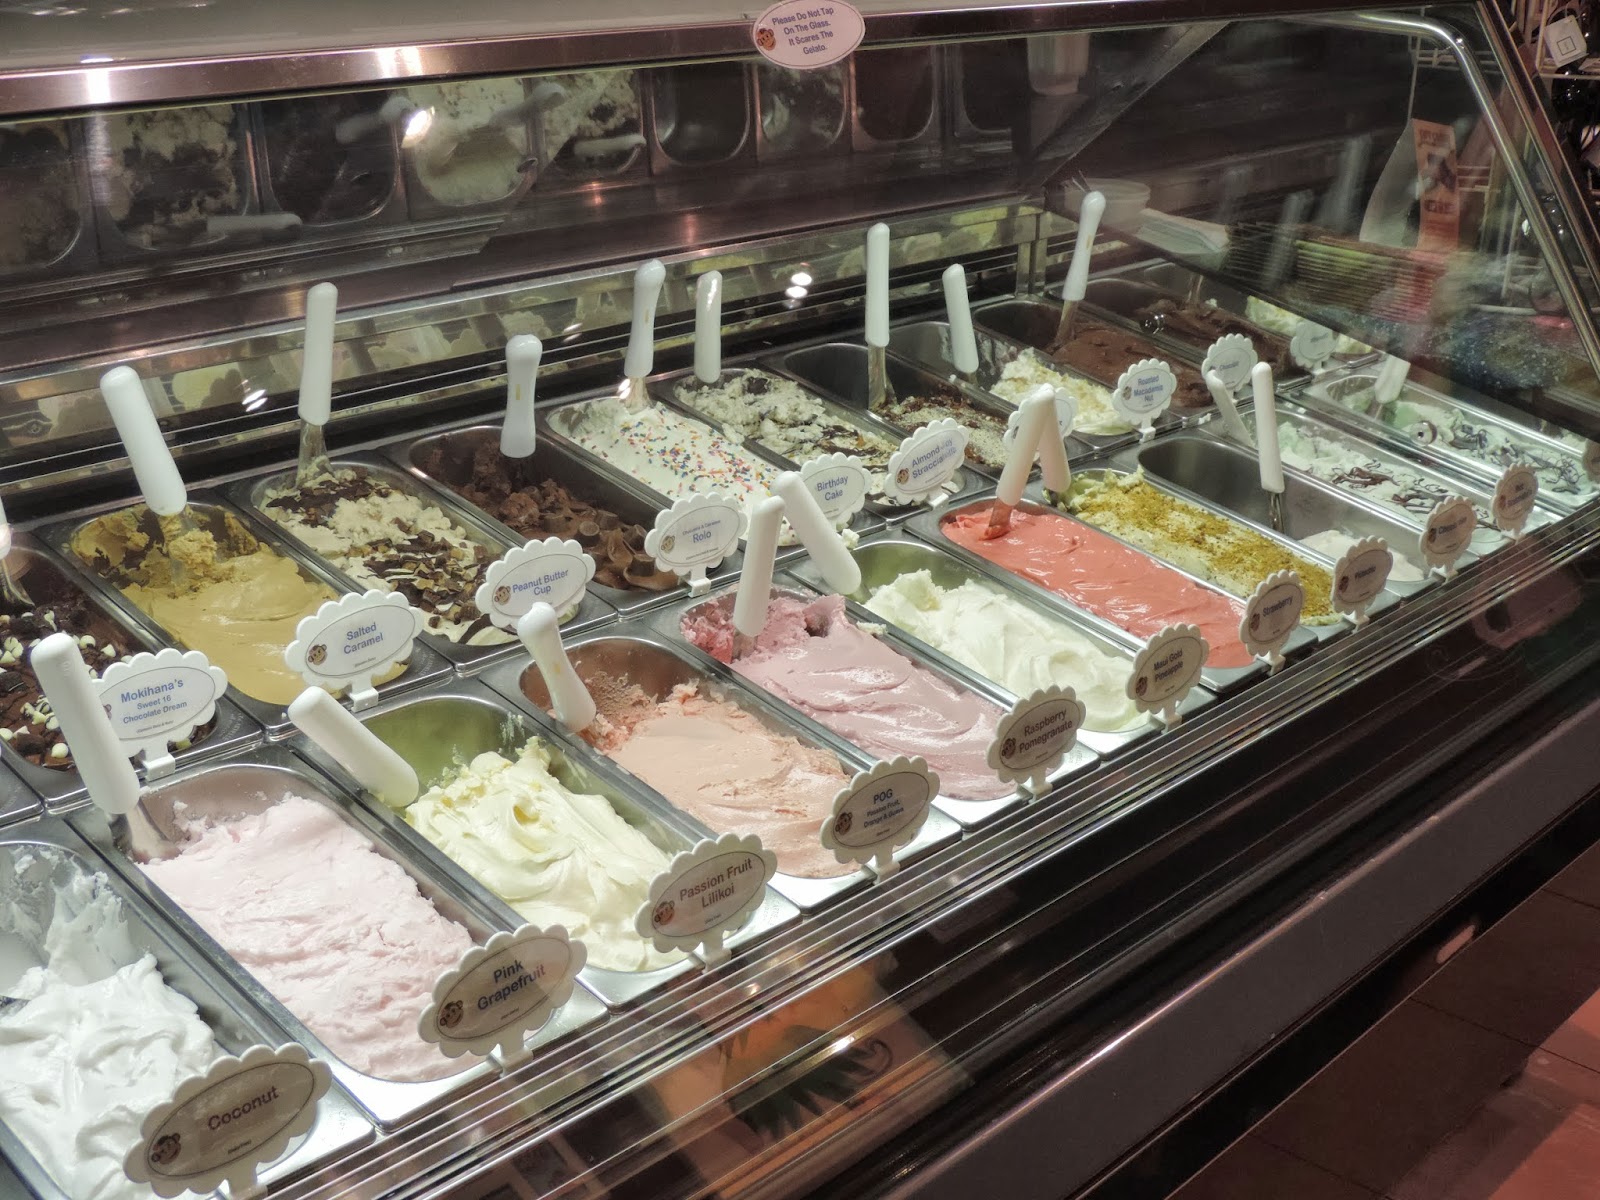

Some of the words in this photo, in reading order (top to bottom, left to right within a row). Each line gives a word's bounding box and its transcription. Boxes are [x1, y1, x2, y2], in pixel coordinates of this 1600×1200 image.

[772, 15, 796, 26] Please
[796, 12, 807, 21] Do
[807, 9, 821, 18] Not
[821, 7, 835, 16] Tap
[783, 27, 795, 36] On
[795, 24, 809, 32] The
[788, 38, 795, 47] It
[795, 33, 820, 45] Scares
[820, 30, 834, 39] The
[912, 444, 941, 468] Almond
[816, 475, 849, 492] Birthday
[824, 489, 844, 501] Cake
[692, 530, 712, 544] Rolo
[512, 576, 543, 593] Peanut
[543, 569, 569, 584] Butter
[533, 584, 552, 597] Cup
[1262, 595, 1293, 617] Strawberry
[346, 621, 377, 641] Salted
[343, 632, 384, 655] Caramel
[1153, 656, 1169, 672] Maui
[1168, 647, 1183, 662] Gold
[1154, 660, 1184, 683] Pineapple
[120, 678, 184, 703] Mokihana's
[136, 698, 161, 710] Sweet
[162, 694, 172, 703] 16
[122, 708, 162, 725] Chocolate
[162, 700, 188, 713] Dream
[1024, 707, 1067, 738] Raspberry
[1018, 720, 1073, 754] Pomegranate
[873, 788, 894, 805] POG
[863, 816, 884, 828] Orange
[888, 807, 905, 818] Guava
[679, 873, 724, 902] Passion
[726, 857, 753, 880] Fruit
[701, 882, 736, 909] Lilikoi
[492, 958, 524, 984] Pink
[477, 964, 546, 1011] Grapefruit
[207, 1085, 280, 1131] Coconut
